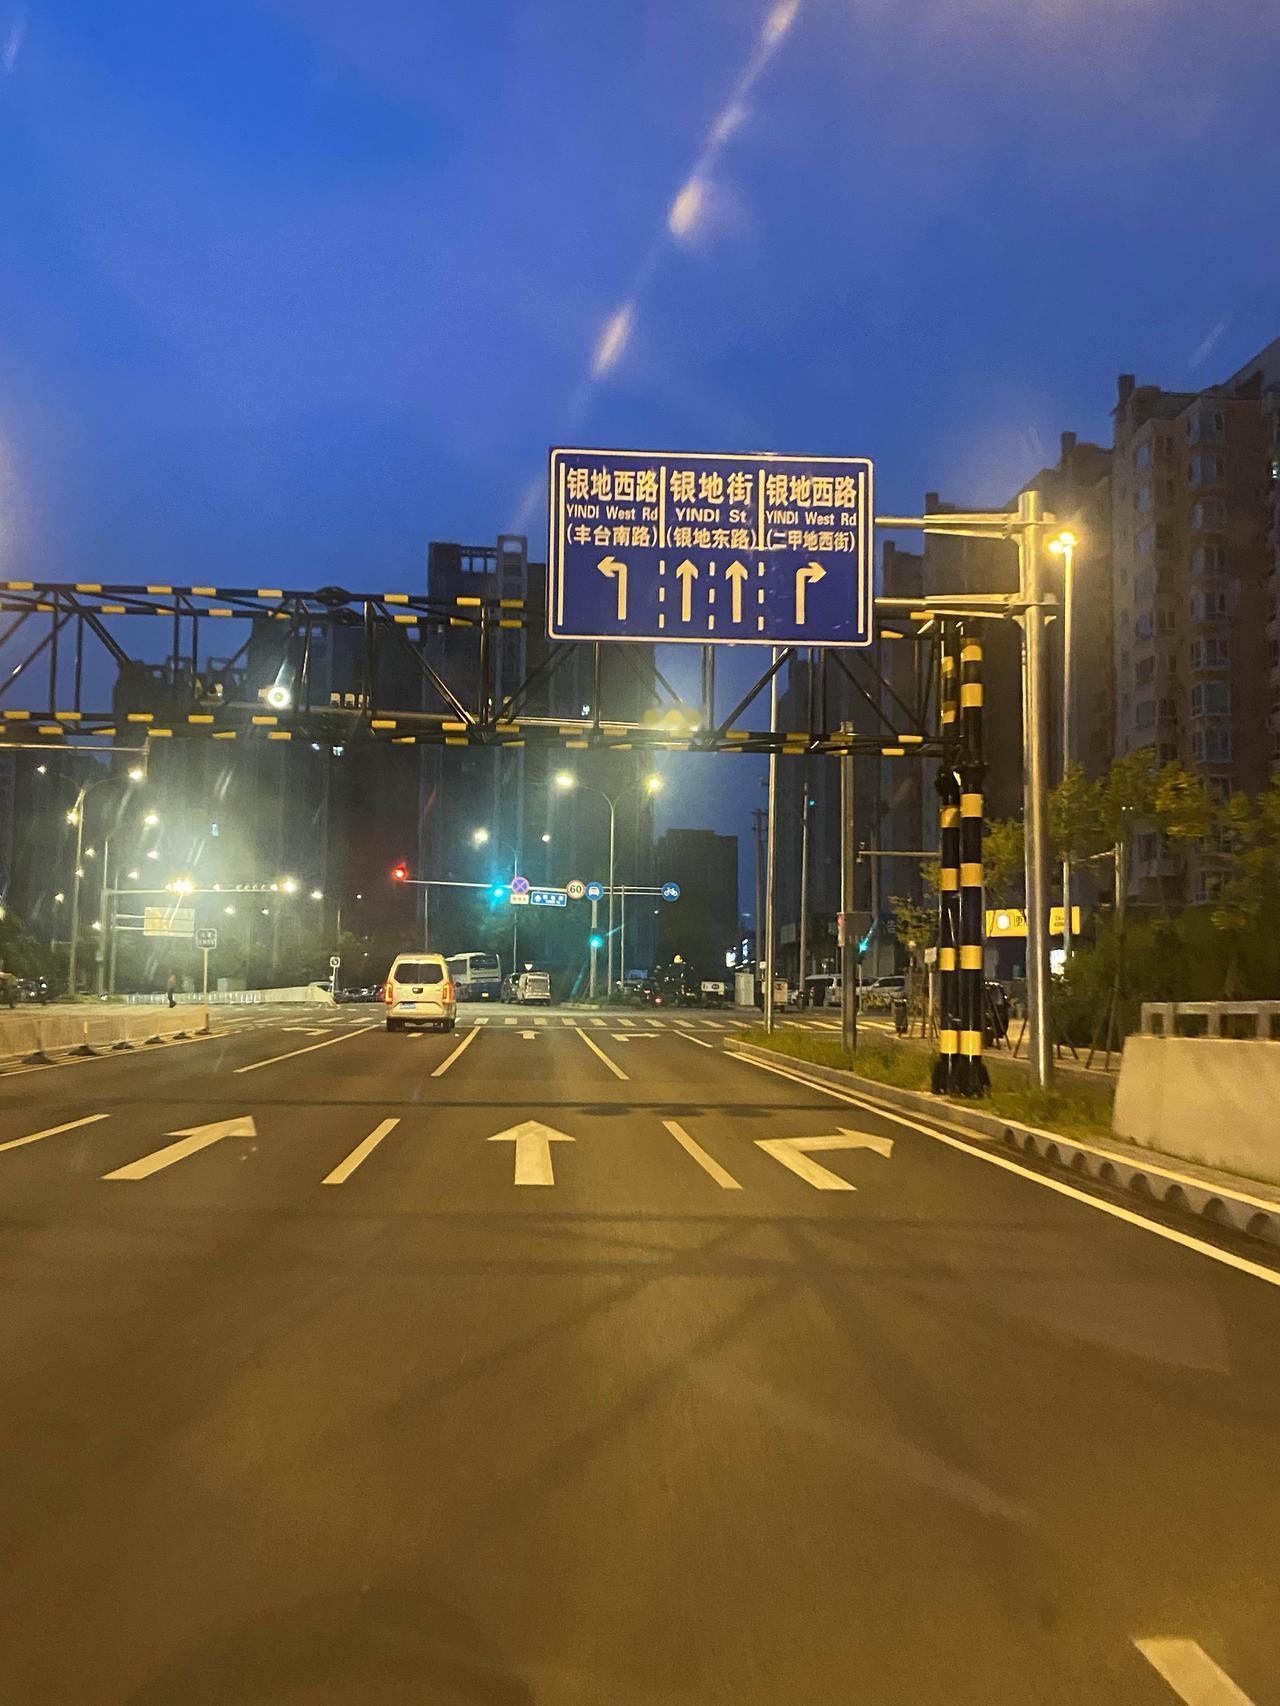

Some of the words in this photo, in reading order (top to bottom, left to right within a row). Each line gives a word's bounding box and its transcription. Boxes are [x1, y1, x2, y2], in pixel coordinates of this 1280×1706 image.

[567, 467, 659, 503] 银地西路
[670, 470, 753, 505] 银地街
[766, 474, 857, 508] 银地西路
[567, 503, 600, 519] YINDI
[606, 505, 636, 520] West
[642, 506, 658, 521] Rd
[675, 507, 720, 522] YINDI
[729, 509, 747, 523] St
[765, 510, 799, 525] YINDI
[804, 511, 835, 526] West
[840, 512, 857, 527] Rd
[566, 522, 658, 547] (丰台南路)
[666, 525, 756, 550] (银地东路)
[766, 528, 856, 553] (二甲地西街)
[569, 885, 582, 894] 60
